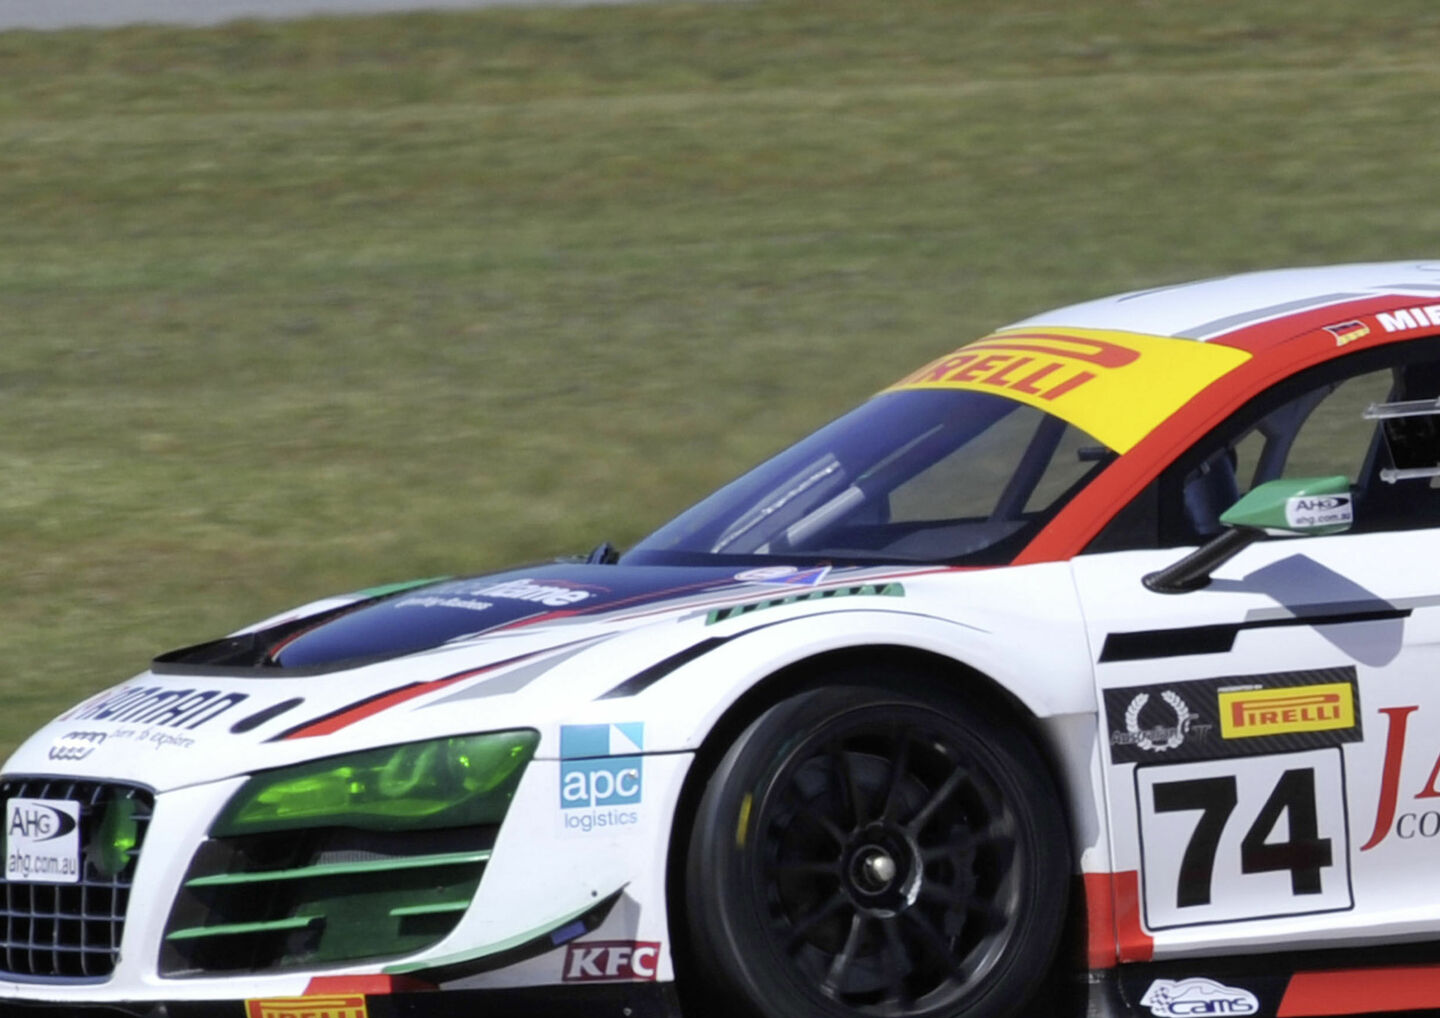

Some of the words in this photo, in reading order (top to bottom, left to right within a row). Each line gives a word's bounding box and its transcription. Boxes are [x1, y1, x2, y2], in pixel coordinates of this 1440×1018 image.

[1230, 694, 1341, 728] PIRELLI
[563, 767, 640, 807] apc
[9, 806, 52, 837] AHG
[564, 810, 638, 832] logistics
[1152, 767, 1333, 908] 74
[8, 849, 77, 878] ahg.com.au
[566, 946, 657, 979] KFC
[1168, 997, 1254, 1015] cams
